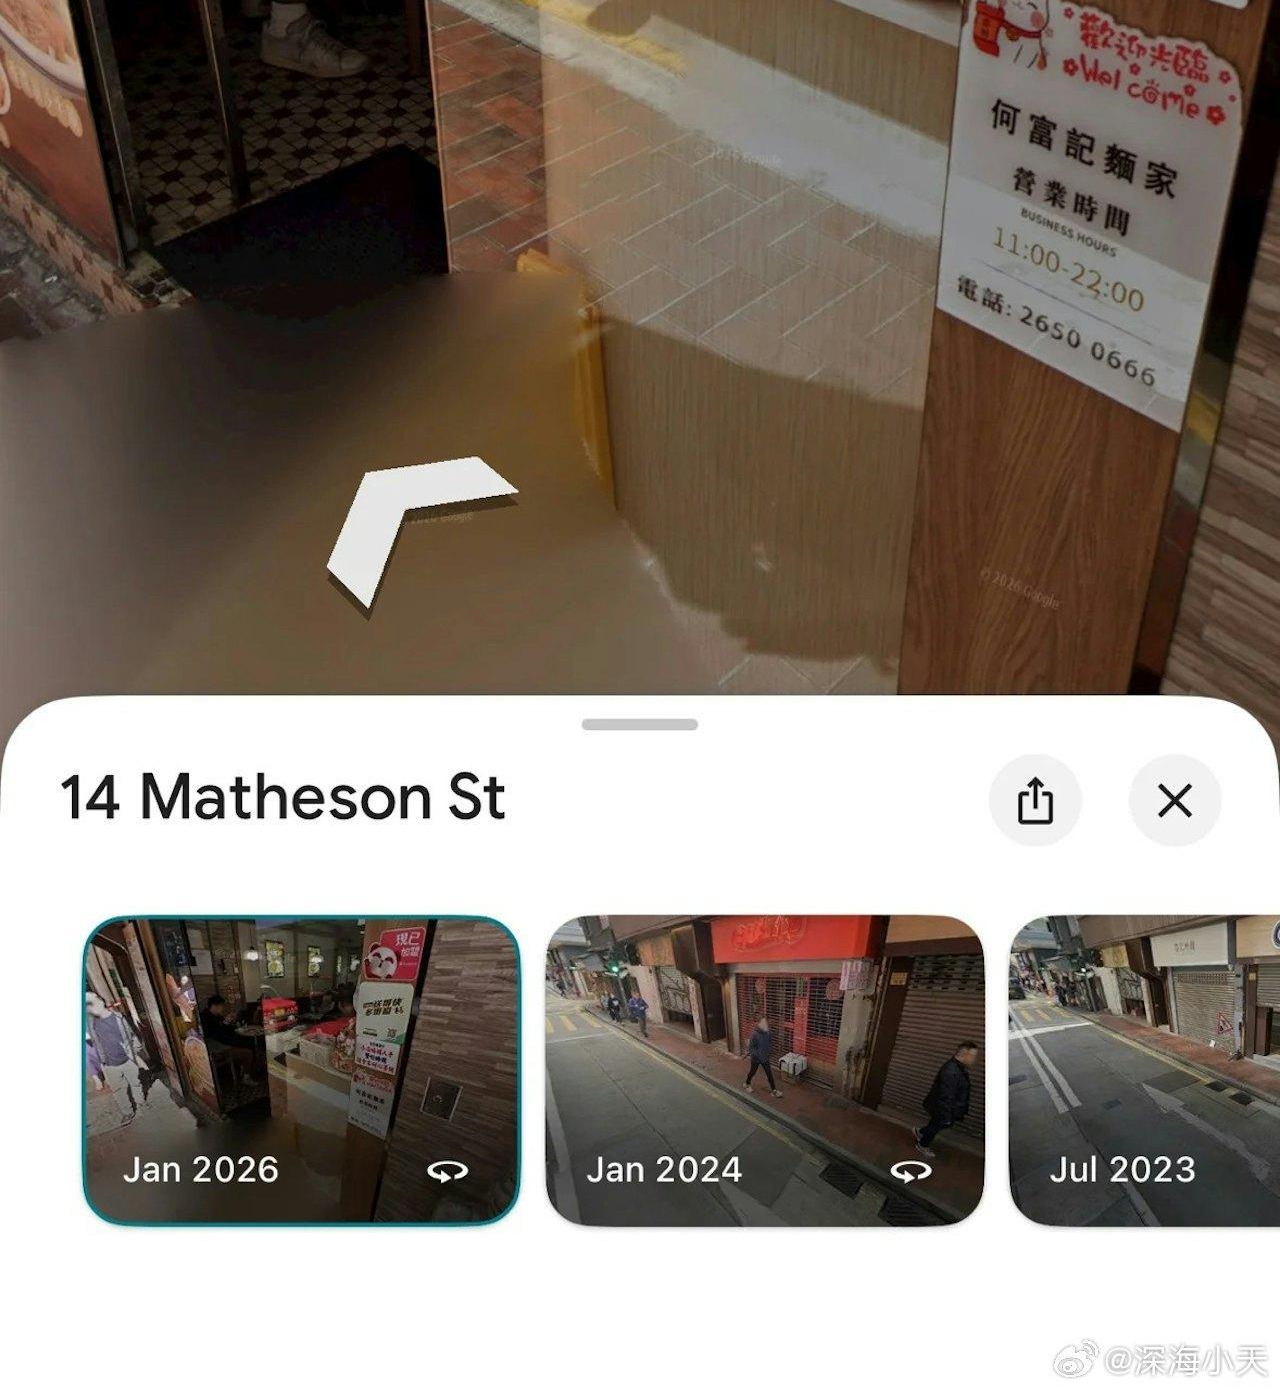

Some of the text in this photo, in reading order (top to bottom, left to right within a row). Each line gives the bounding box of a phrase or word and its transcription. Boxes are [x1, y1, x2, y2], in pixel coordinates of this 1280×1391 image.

[1079, 11, 1210, 84] 歡迎光臨
[990, 98, 1178, 199] 何富記麵家
[1013, 166, 1131, 237] 營業時間
[1020, 207, 1118, 258] BUSINESS HOURS
[993, 226, 1145, 313] 11:00-22:00
[1020, 305, 1082, 349] 2650
[1090, 341, 1156, 388] 0666
